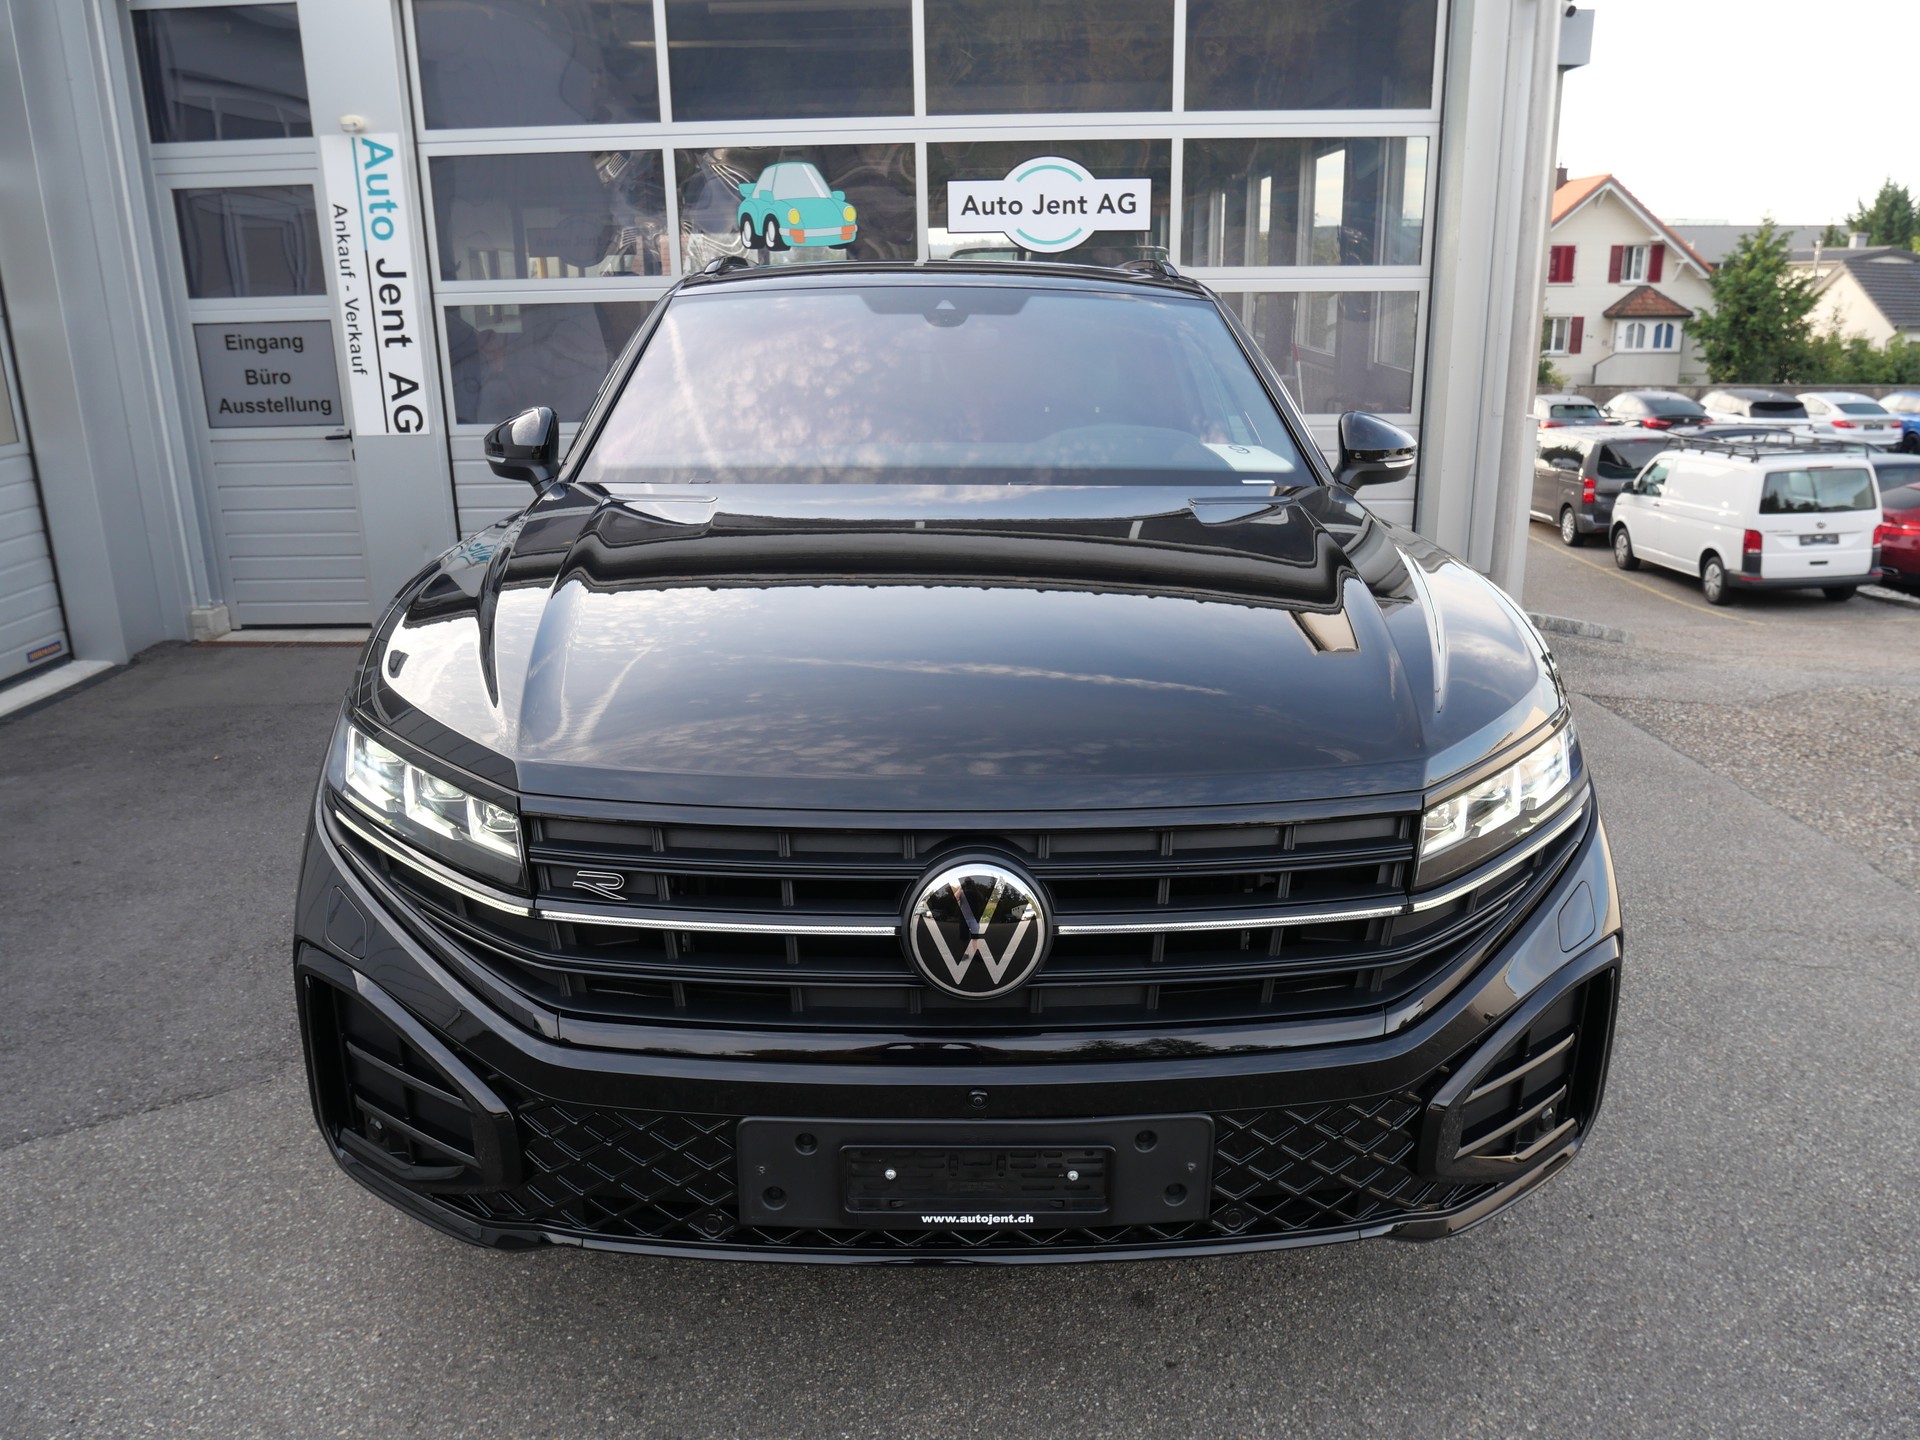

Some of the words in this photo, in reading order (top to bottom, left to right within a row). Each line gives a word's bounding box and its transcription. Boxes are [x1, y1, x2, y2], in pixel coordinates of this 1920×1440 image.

[361, 137, 399, 241] Auto
[961, 194, 1023, 216] Auto
[1032, 193, 1088, 215] Jent
[1096, 192, 1137, 214] AG
[332, 203, 356, 279] Ankauf
[344, 297, 368, 376] Verkauf
[376, 258, 413, 348] Jent
[224, 334, 304, 354] Eingang
[244, 368, 292, 385] Büro
[219, 396, 332, 416] Ausstellung
[388, 372, 424, 433] AG
[572, 870, 628, 900] R
[921, 1213, 1034, 1226] www.autojent.ch
